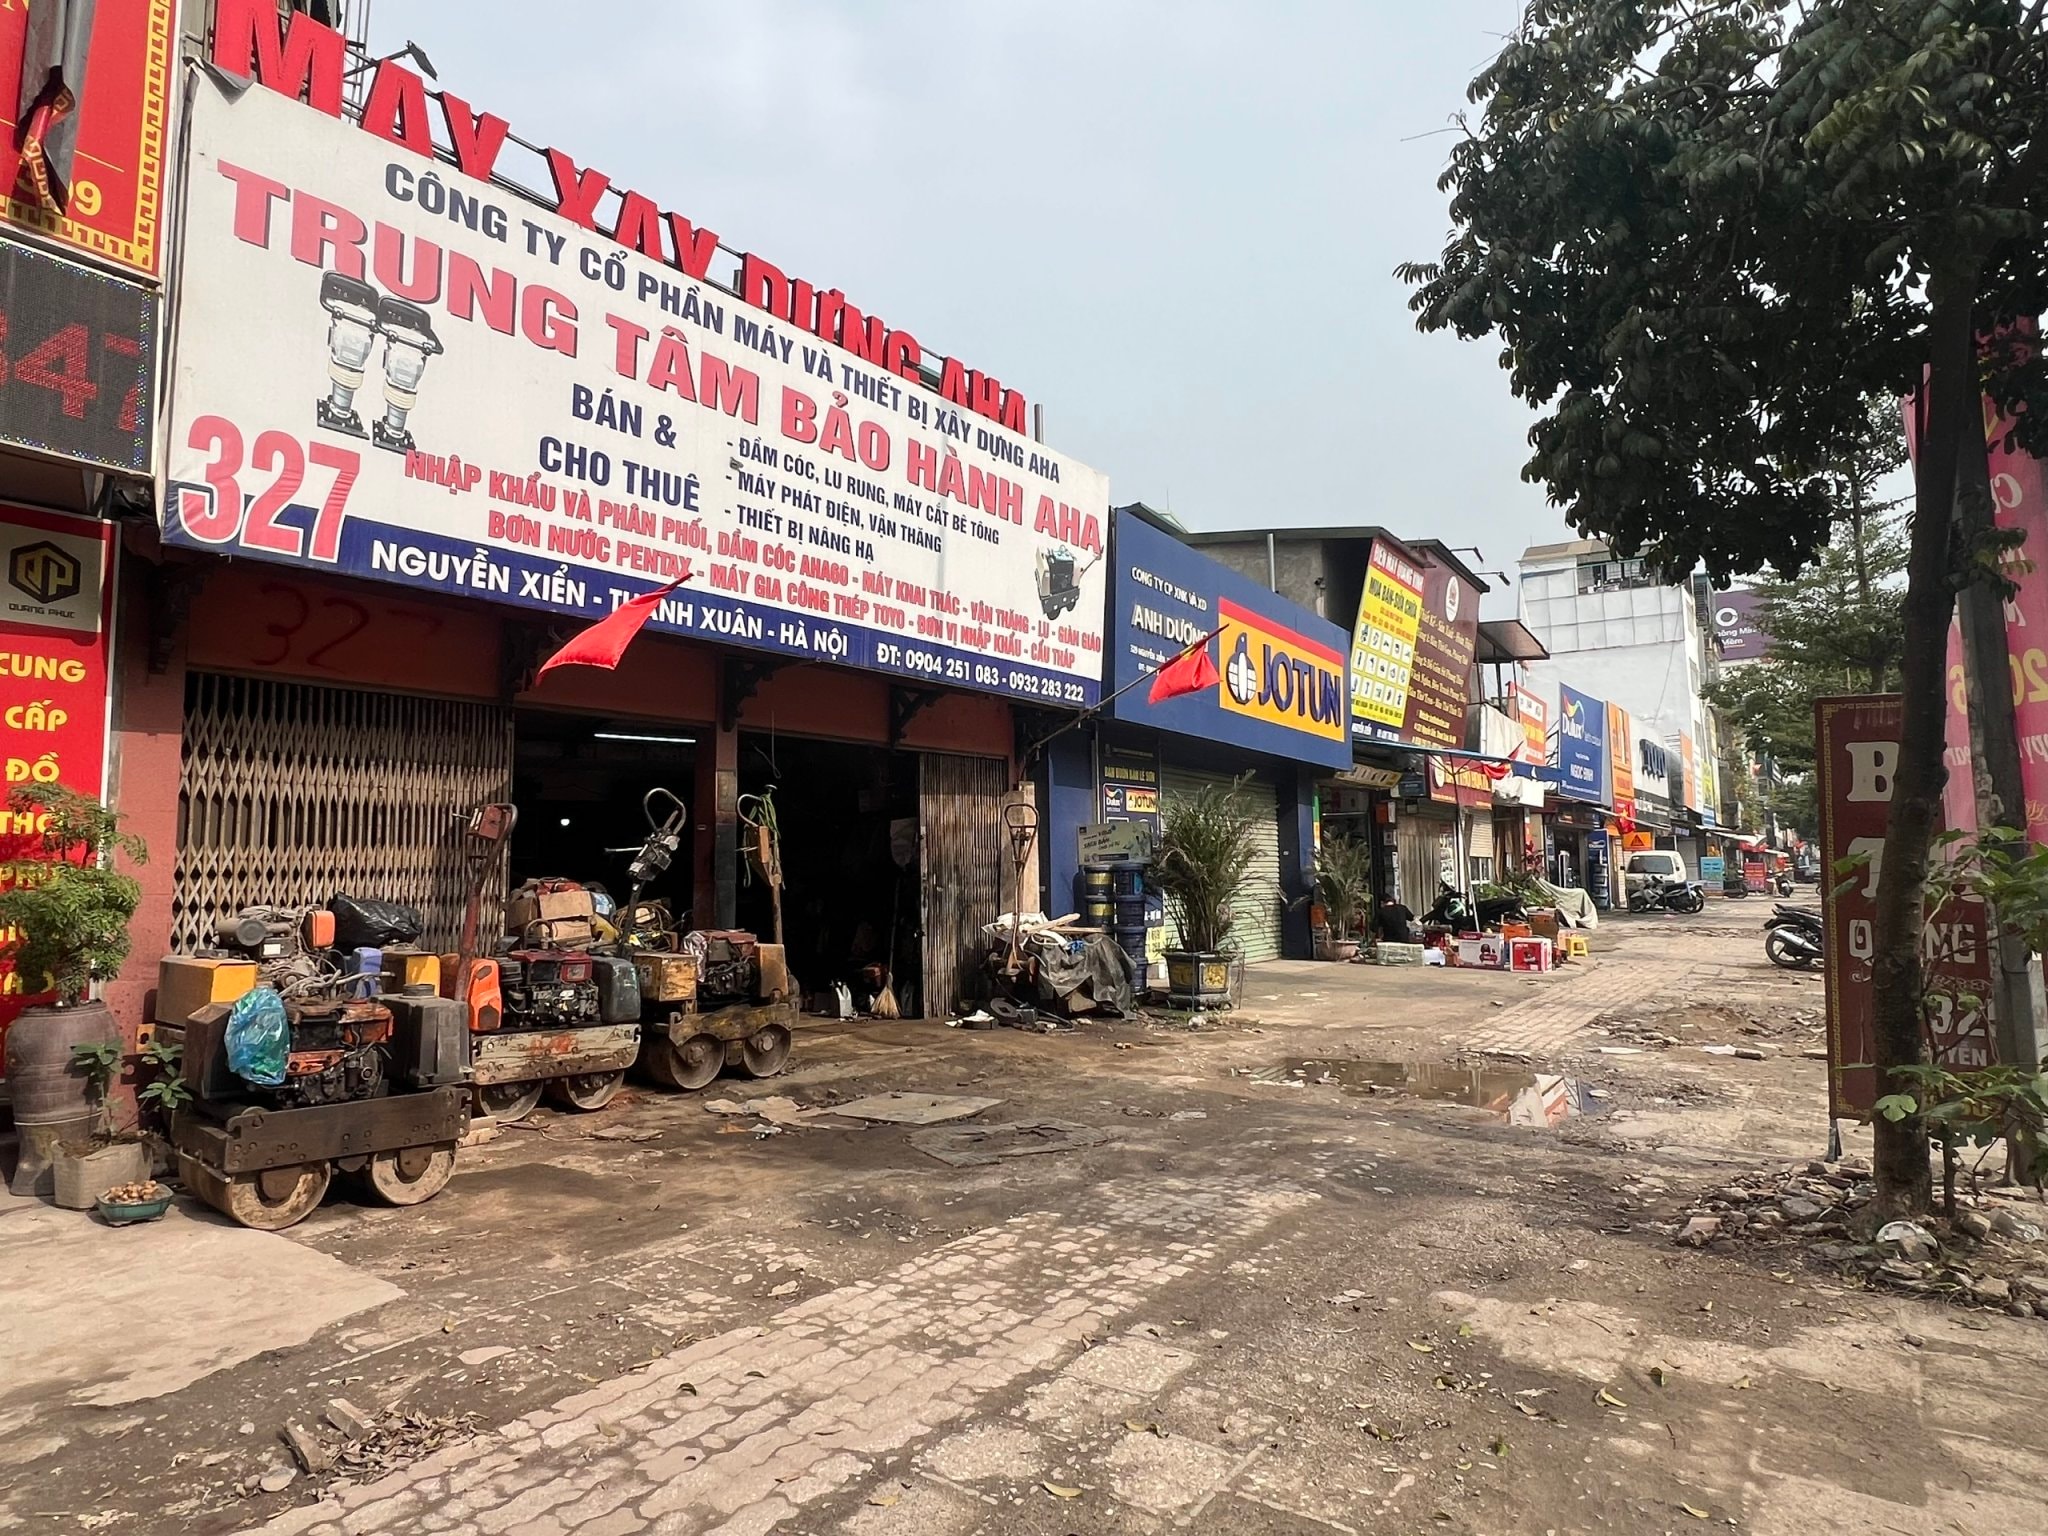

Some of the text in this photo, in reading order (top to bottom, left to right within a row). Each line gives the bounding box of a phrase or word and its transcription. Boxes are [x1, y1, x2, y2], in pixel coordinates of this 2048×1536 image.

[217, 159, 1103, 556] TRUNG TÂM BẢO HÀNH AHA
[386, 163, 1060, 484] CÔNG TY CỔ PHẦN MÁY VÀ THIẾT BỊ XÂY DỰNG AHA
[572, 383, 676, 449] BÁN &
[178, 415, 361, 563] 327
[539, 436, 700, 513] CHO THUÊ
[738, 472, 942, 553] MÁY PHÁT ĐIỆN, VẬN THĂNG
[739, 436, 999, 545] ĐẦM CÓC, LU RUNG, MÁY CẮT BÊ TÔNG
[405, 449, 481, 495] NHẬP
[489, 470, 556, 512] KHẨU
[563, 488, 592, 522] VÀ
[598, 499, 656, 537] PHÂN
[662, 516, 712, 555] PHỐI,
[763, 543, 796, 572] CÓC
[799, 553, 849, 587] AHA60
[862, 571, 893, 598] MÁY
[896, 578, 926, 607] KHAI
[930, 589, 960, 616] THÁC
[971, 600, 993, 626] VẬN
[1038, 620, 1050, 639] LU
[737, 504, 874, 564] THIẾT BỊ NÂNG HẠ
[371, 540, 510, 593] NGUYỄN
[518, 564, 586, 608] XIỂN
[700, 605, 763, 640] XUÂN
[780, 620, 808, 649] HÀ
[814, 627, 848, 661] NỘI
[548, 525, 611, 563] NƯỚC
[616, 540, 692, 580] PENTAX
[710, 563, 750, 594] MÁY
[754, 574, 782, 602] GIA
[787, 582, 830, 613] CÔNG
[833, 593, 869, 621] THÉP
[873, 603, 905, 630] TOYO
[946, 622, 958, 646] VỊ
[961, 625, 991, 653] NHẬP
[1052, 650, 1075, 670] THÁP
[1131, 603, 1163, 636] ANH
[877, 642, 1085, 702] ĐT: 0904 251 083 0932 283 222
[1258, 644, 1341, 728] JOTUN
[4, 699, 68, 732] CẤP
[1562, 712, 1585, 740] Dulux
[6, 751, 60, 783] ĐỒ
